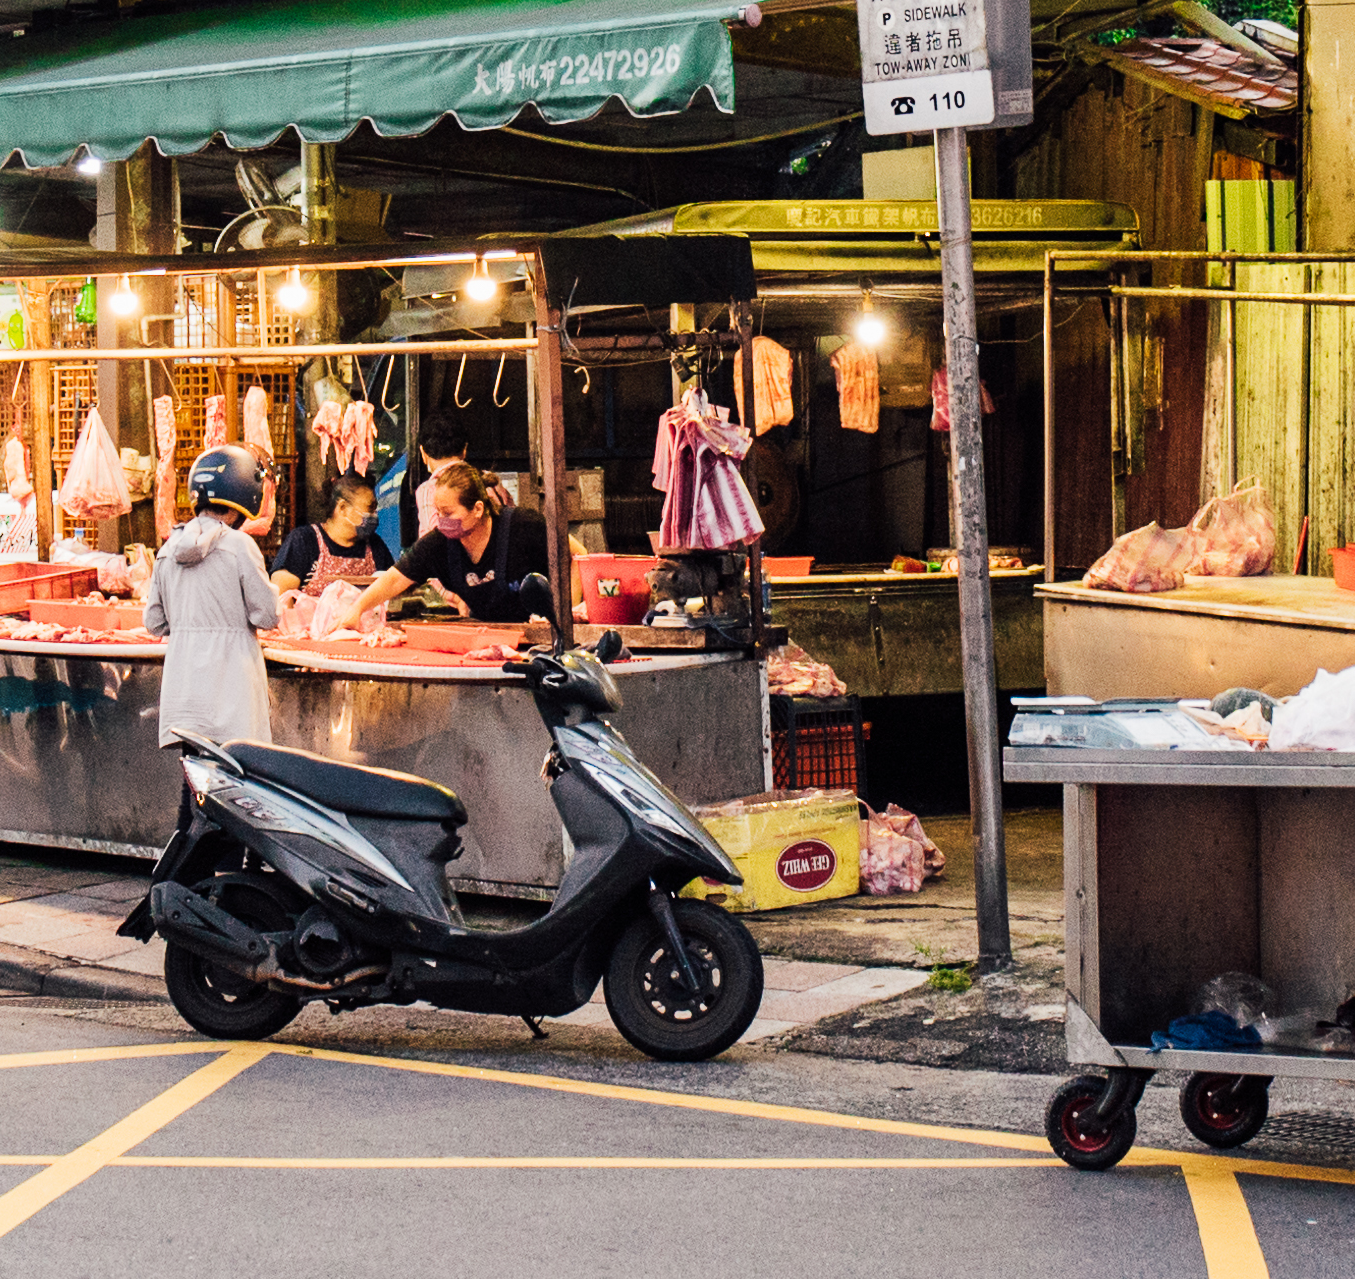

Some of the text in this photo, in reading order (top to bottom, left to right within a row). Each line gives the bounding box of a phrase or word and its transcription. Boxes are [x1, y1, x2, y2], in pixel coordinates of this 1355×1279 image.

[904, 2, 967, 23] SIDEWALK
[884, 28, 962, 55] 違者拖吊
[875, 53, 971, 76] TOW-AWAY ZON
[929, 90, 966, 111] 110
[781, 854, 830, 876] GEE WHIZ
